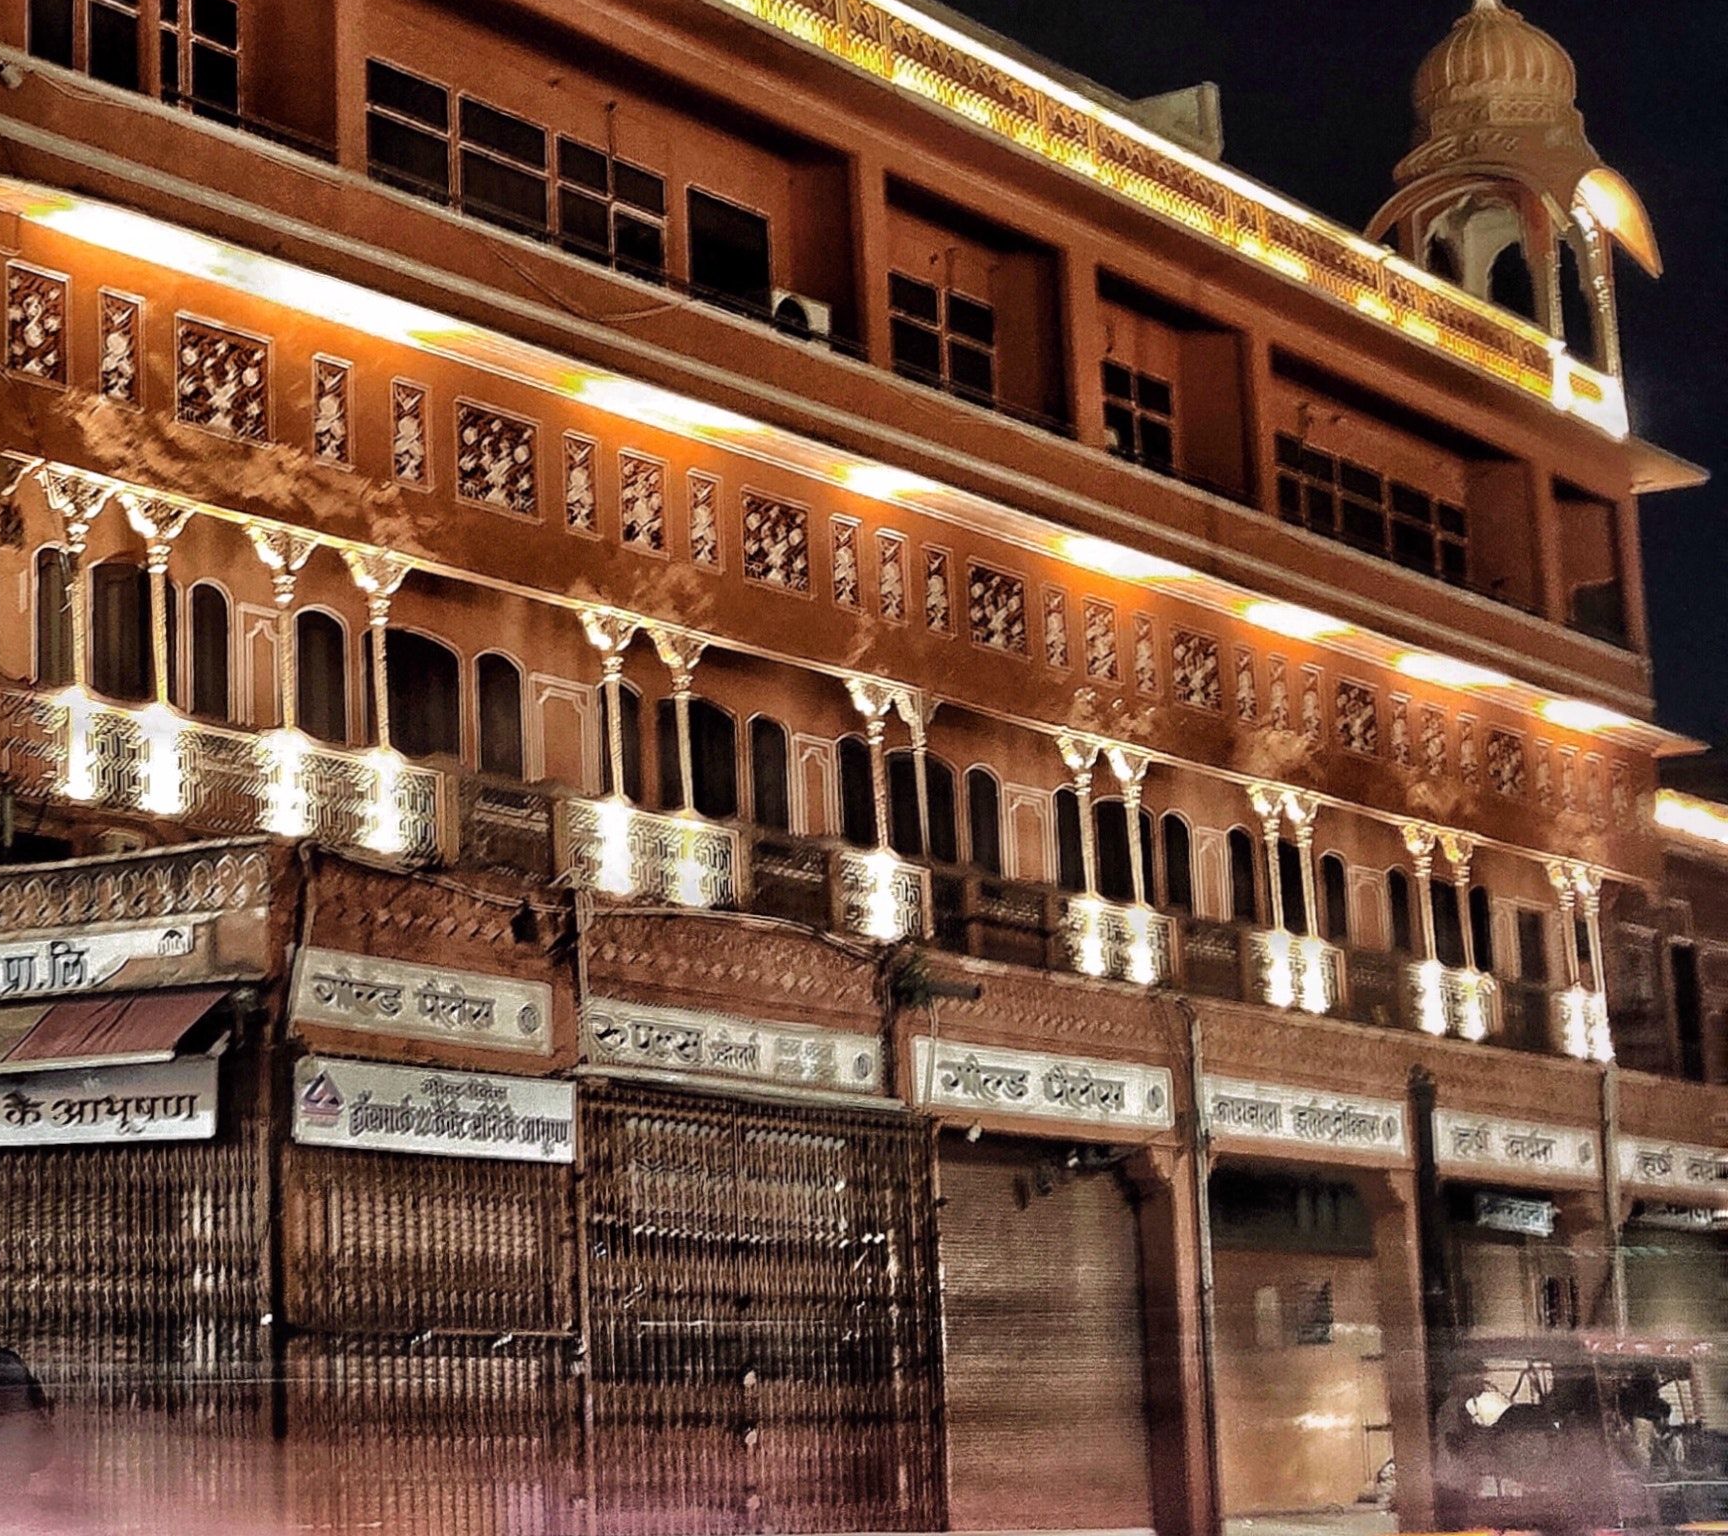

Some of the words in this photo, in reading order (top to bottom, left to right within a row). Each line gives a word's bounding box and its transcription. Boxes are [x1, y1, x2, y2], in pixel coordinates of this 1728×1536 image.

[313, 966, 404, 1017] गोल्ड
[936, 1053, 1030, 1103] गोल्ड
[51, 1092, 202, 1135] आभूषण
